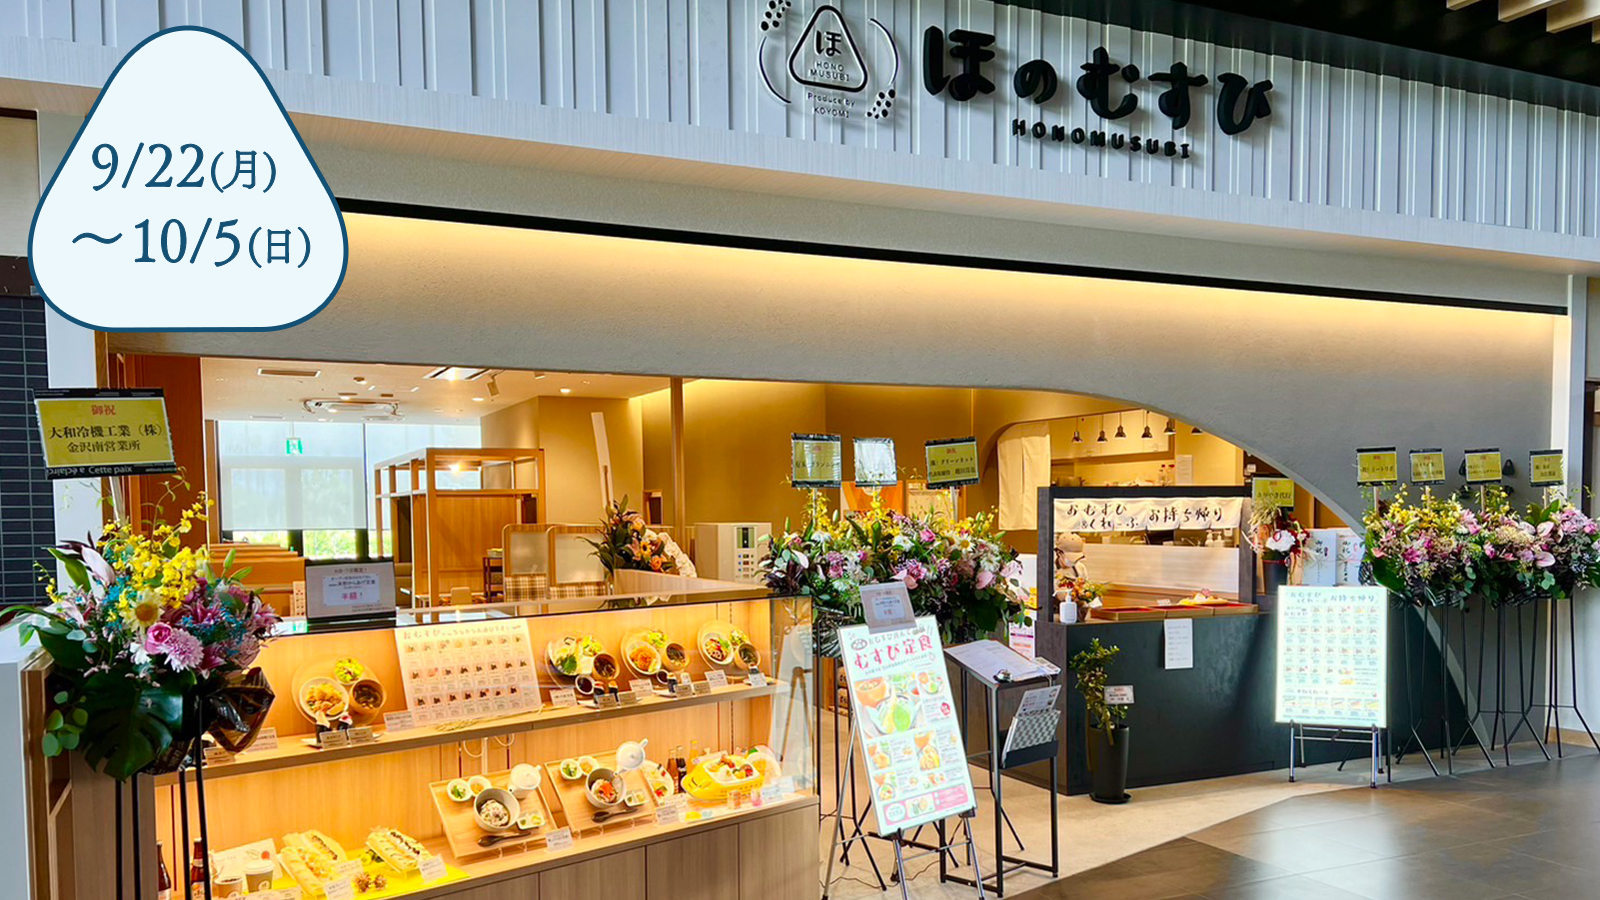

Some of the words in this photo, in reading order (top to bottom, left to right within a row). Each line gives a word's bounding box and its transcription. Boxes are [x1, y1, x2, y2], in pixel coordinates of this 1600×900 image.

[815, 30, 842, 57] ほ
[816, 61, 845, 72] HONO
[810, 69, 850, 82] MUSUBI
[923, 25, 1274, 136] ほのむすび
[807, 92, 842, 105] Produce
[844, 99, 856, 108] by
[814, 107, 850, 119] KOYOMI
[1012, 118, 1191, 159] HONOMUSUBI
[91, 404, 116, 416] 御祝
[50, 425, 131, 440] 大和冷機工業
[67, 440, 141, 453] 金沢南営業所
[88, 465, 112, 475] Cette
[114, 465, 133, 475] paix
[1067, 504, 1127, 516] おむすび
[1149, 506, 1222, 523] お持ち帰り
[854, 634, 933, 670] むすび定食
